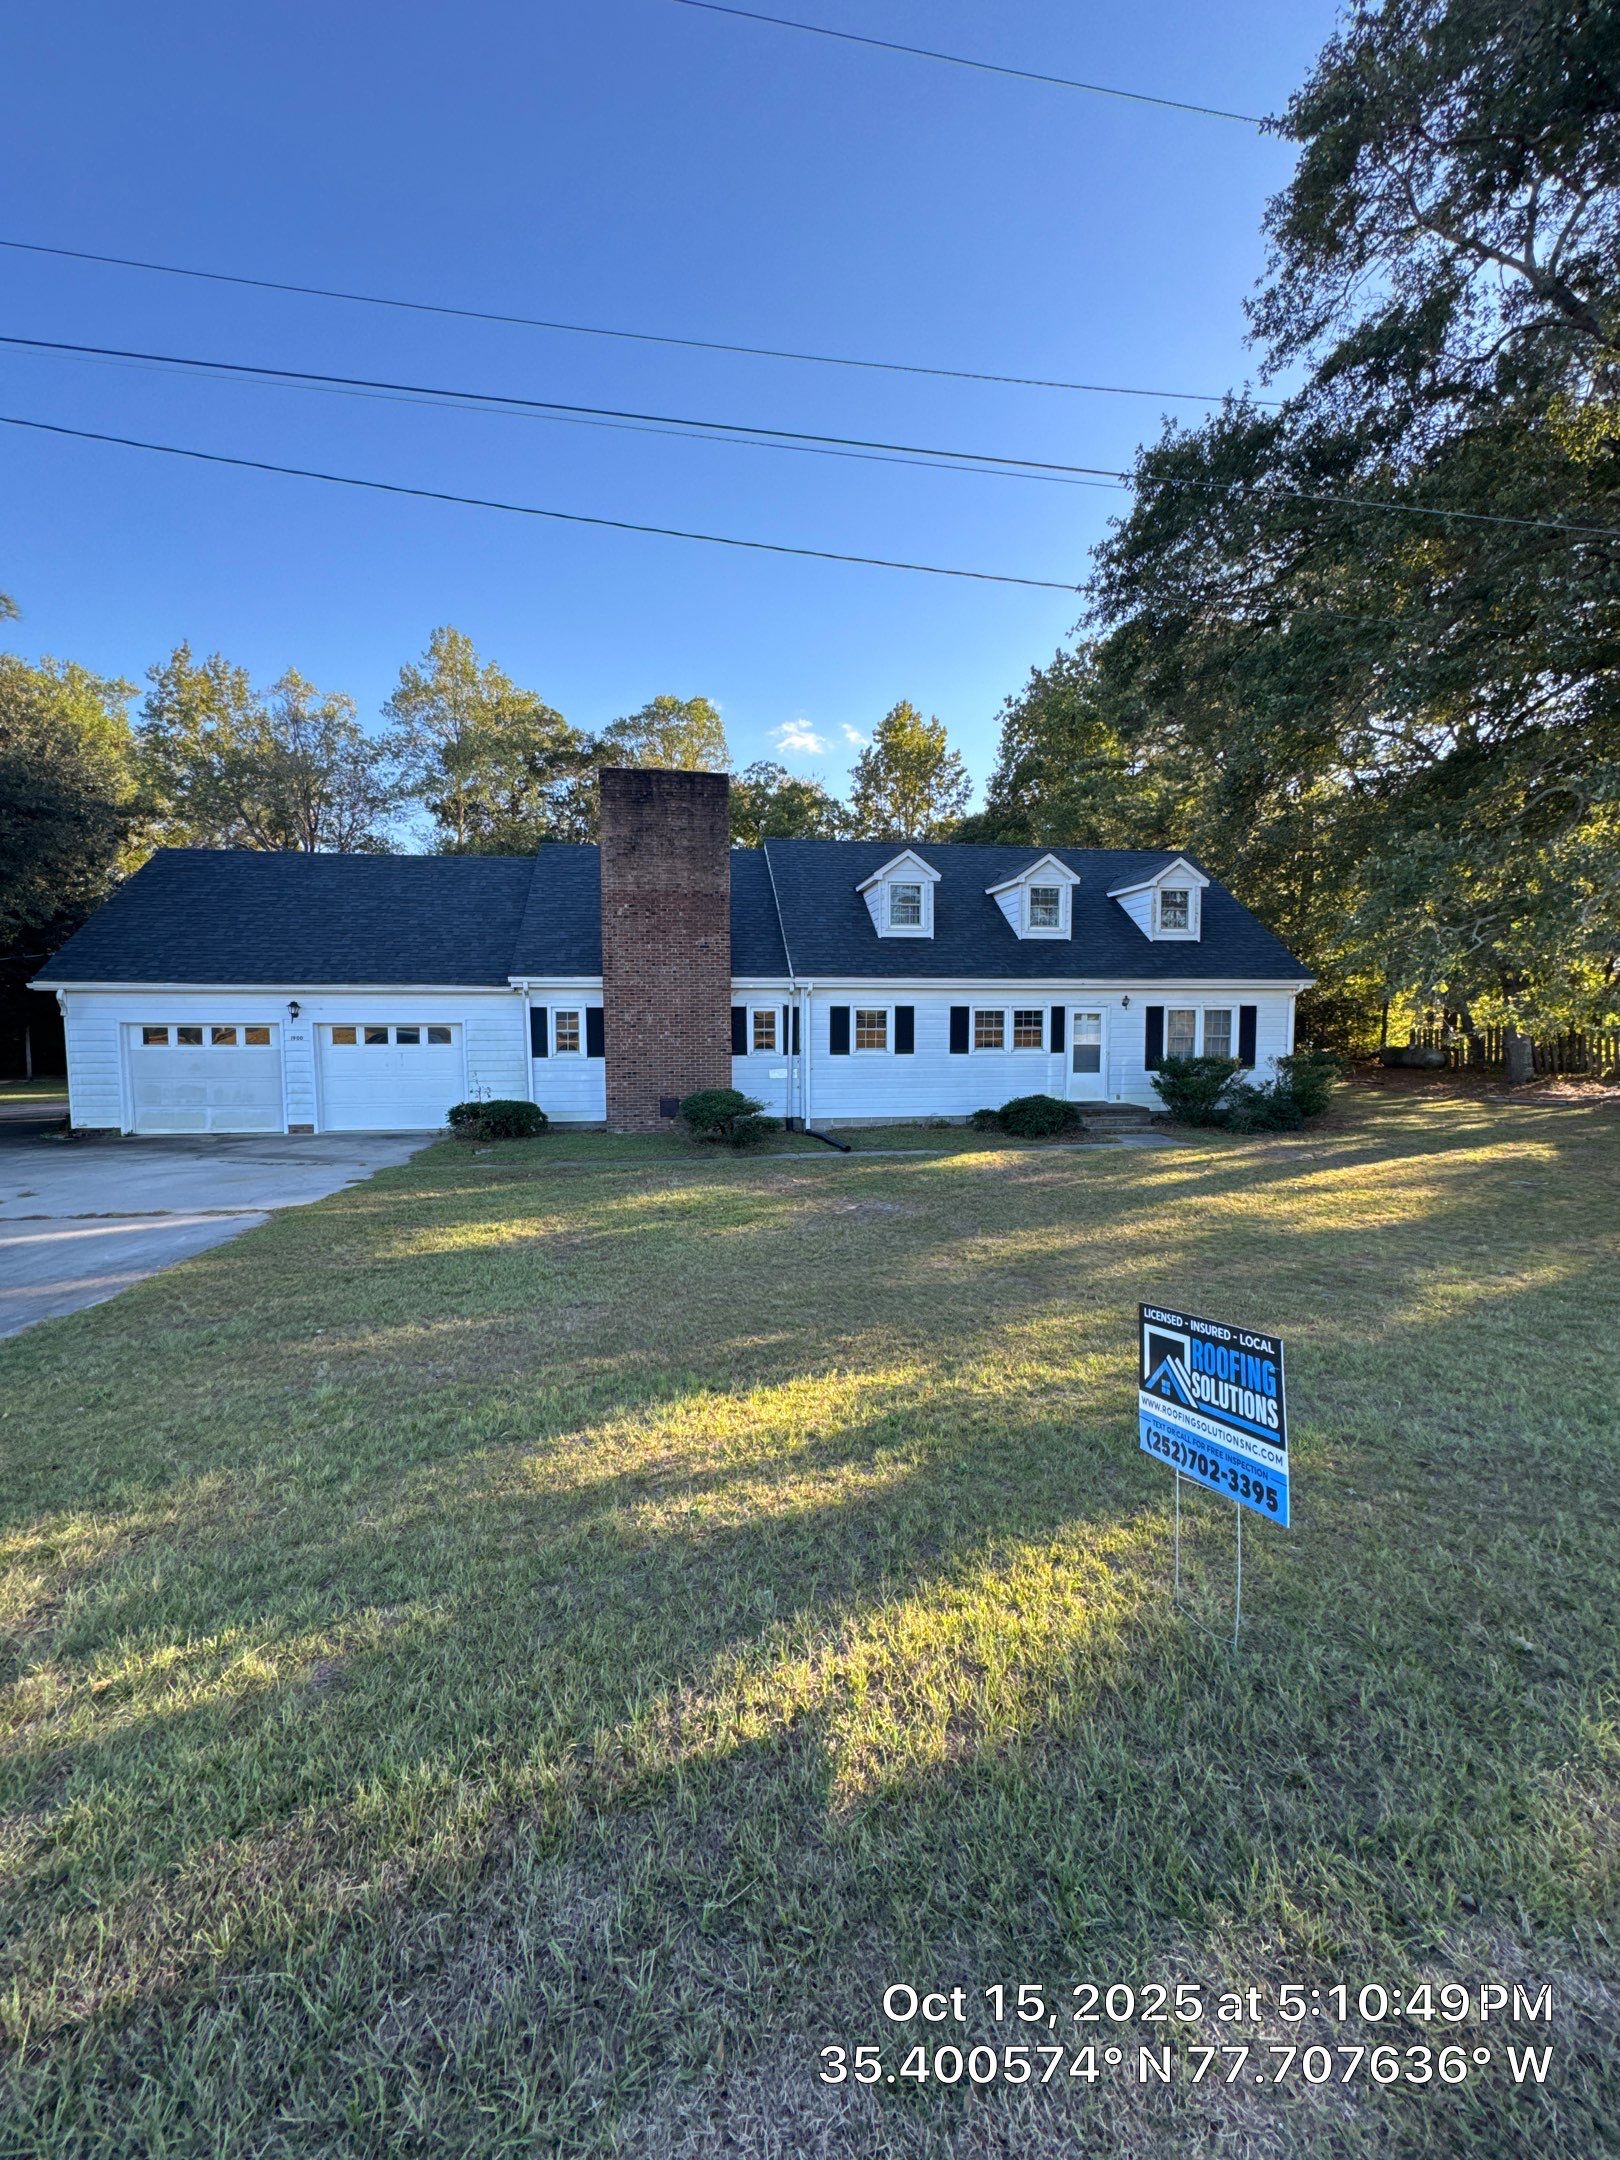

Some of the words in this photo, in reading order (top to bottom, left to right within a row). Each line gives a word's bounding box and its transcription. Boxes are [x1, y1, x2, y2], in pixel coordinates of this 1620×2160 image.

[1143, 1307, 1183, 1327] LICENSED
[1190, 1320, 1231, 1341] INSURED
[1239, 1333, 1275, 1354] LOCAL
[1192, 1338, 1277, 1398] ROOFING
[1191, 1371, 1279, 1429] SOLUTIONS
[1141, 1396, 1283, 1466] WWW.ROOFINGSOLUTIONSNC.COM
[1152, 1419, 1166, 1432] TEXT
[1166, 1425, 1176, 1435] OR
[1175, 1429, 1191, 1444] CALL
[1192, 1438, 1206, 1450] FOR
[1206, 1445, 1224, 1458] FREE
[1225, 1452, 1269, 1480] INSPECTION
[1146, 1426, 1279, 1513] (252)702-3395
